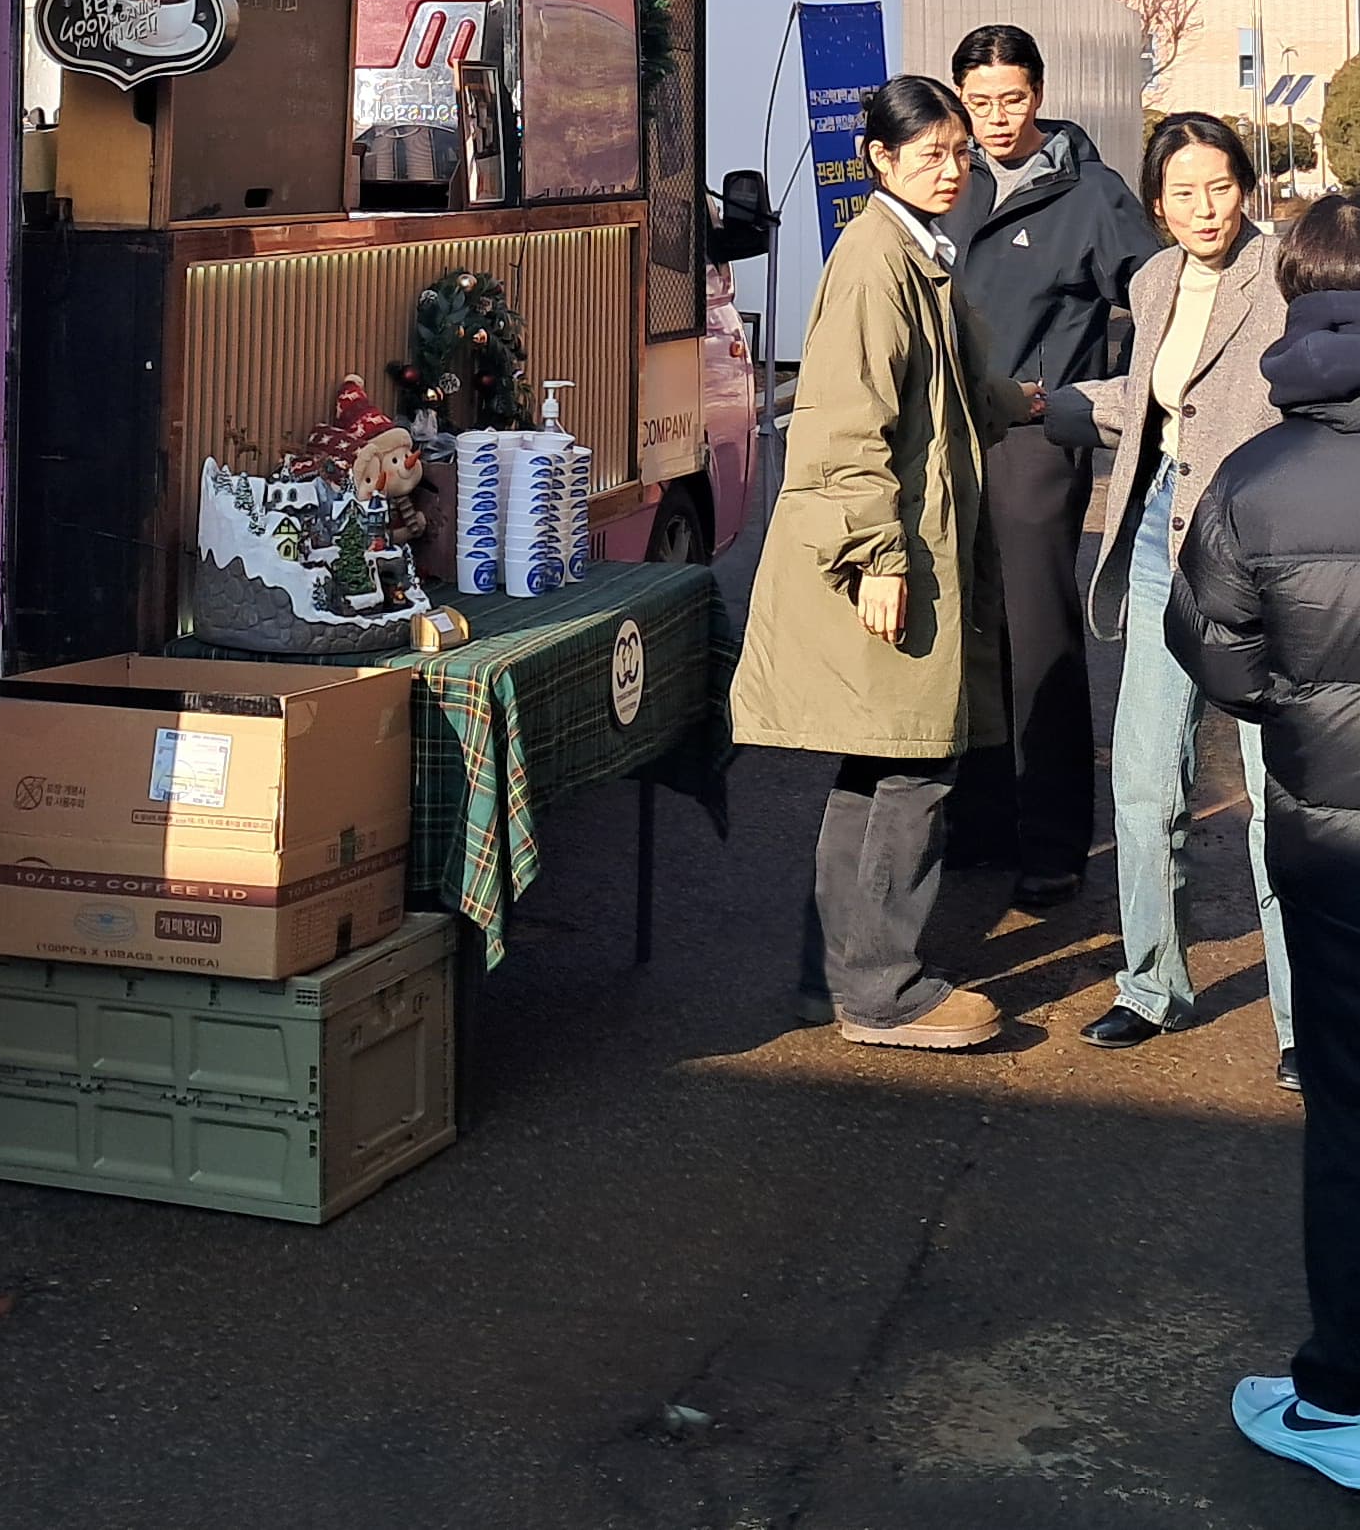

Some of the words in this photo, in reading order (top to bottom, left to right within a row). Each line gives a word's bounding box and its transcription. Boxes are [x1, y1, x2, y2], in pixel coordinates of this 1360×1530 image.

[60, 13, 109, 44] GOOD
[74, 31, 99, 57] YOU
[642, 412, 693, 448] COMPANY
[15, 871, 97, 888] 10/13oz
[106, 879, 200, 897] COFFEE
[207, 887, 248, 900] LID
